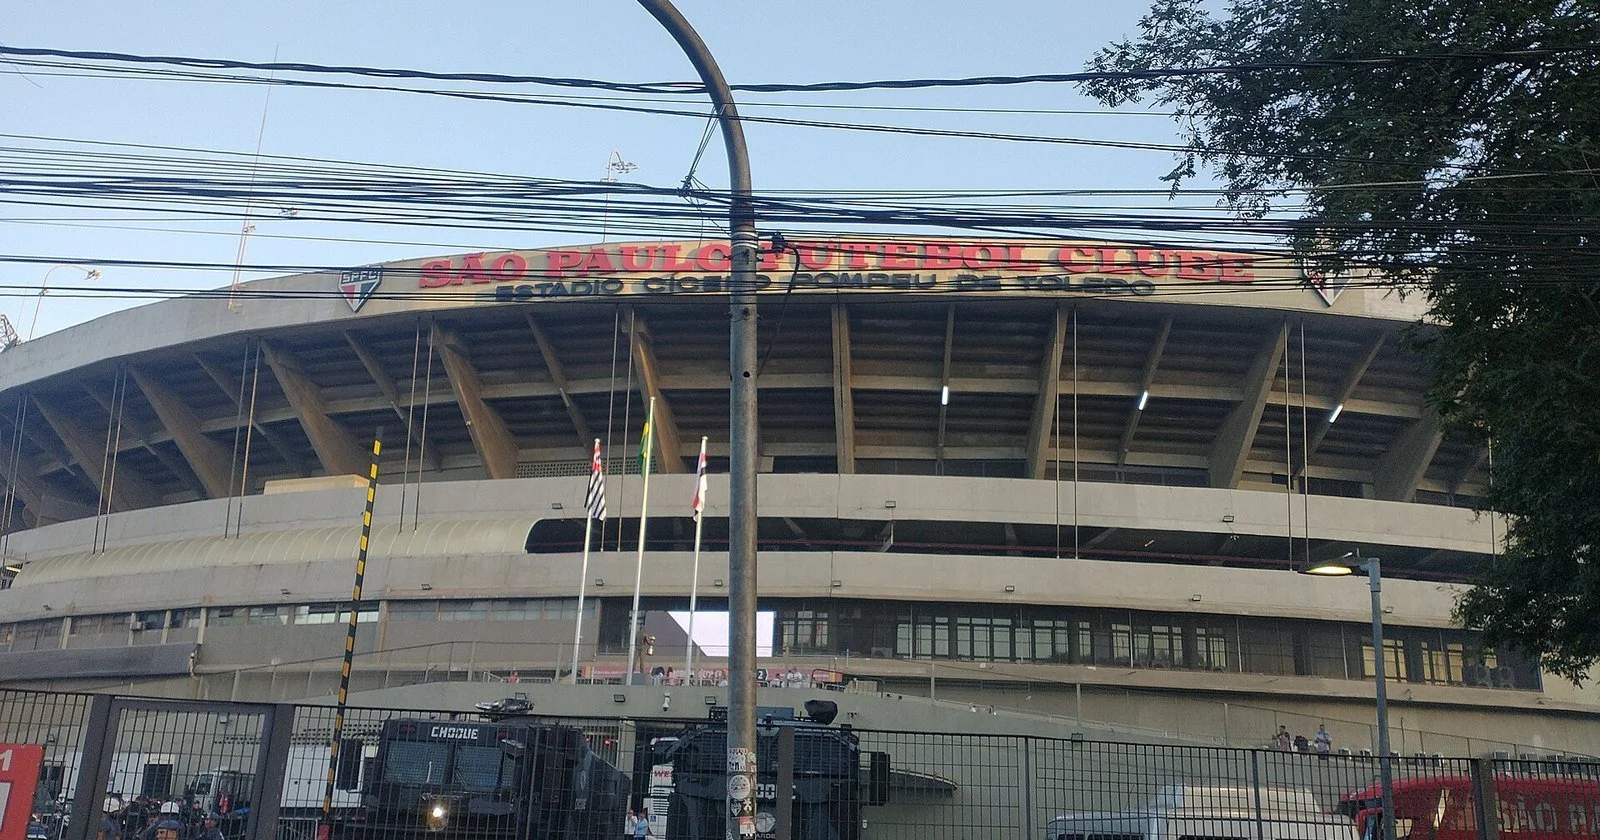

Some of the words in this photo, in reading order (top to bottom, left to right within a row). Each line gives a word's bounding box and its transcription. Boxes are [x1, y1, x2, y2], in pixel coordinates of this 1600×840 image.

[419, 251, 528, 288] SÃO
[544, 243, 732, 276] PAULO
[758, 240, 1040, 272] FUTEBOL
[1058, 246, 1254, 283] CLUBE
[643, 273, 772, 293] CÍCEO
[794, 272, 937, 290] POMPEU
[957, 274, 1002, 290] DE
[431, 726, 479, 740] CHOQUE
